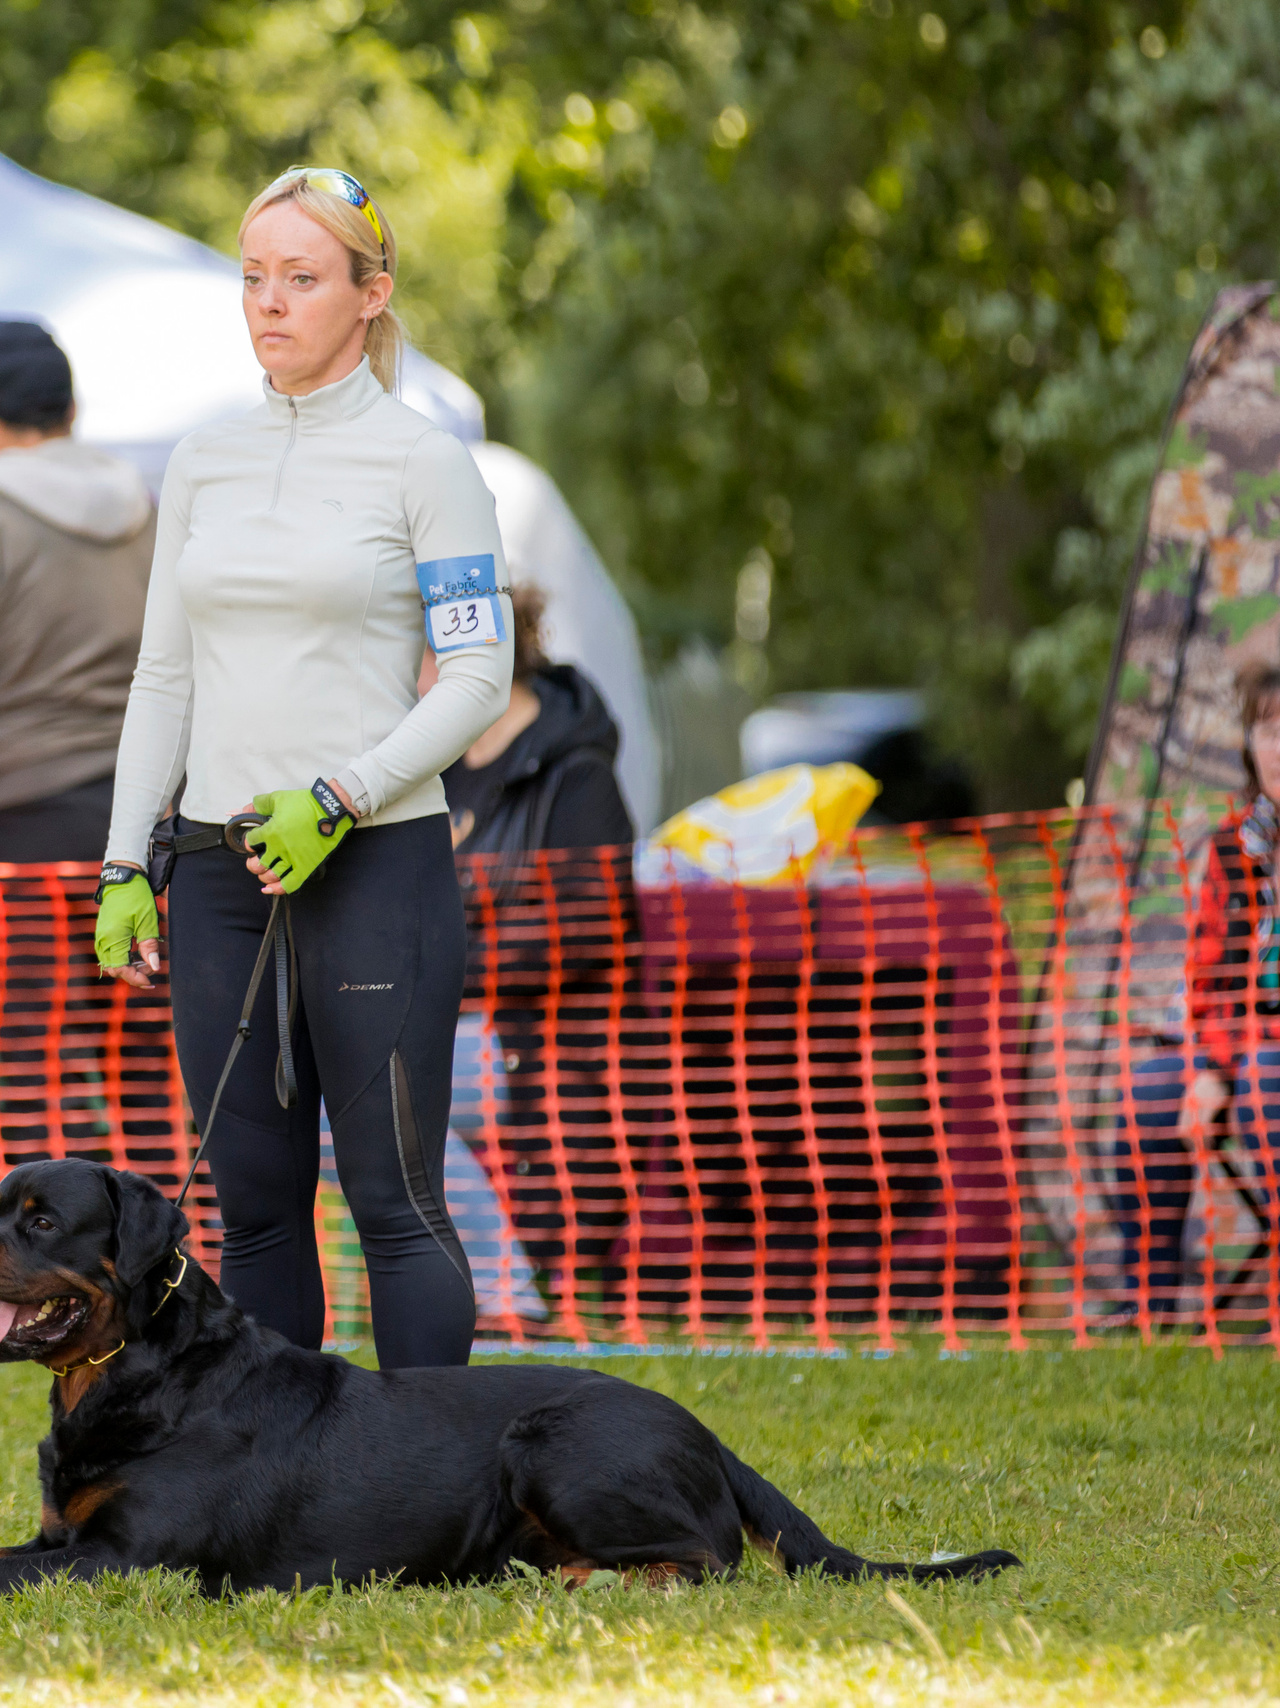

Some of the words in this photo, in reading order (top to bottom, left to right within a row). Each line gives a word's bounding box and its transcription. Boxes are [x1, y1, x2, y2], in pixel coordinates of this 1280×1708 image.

[428, 584, 444, 596] Pet
[445, 580, 478, 592] Fabric
[442, 603, 479, 637] 33
[349, 983, 395, 991] DEMIX
